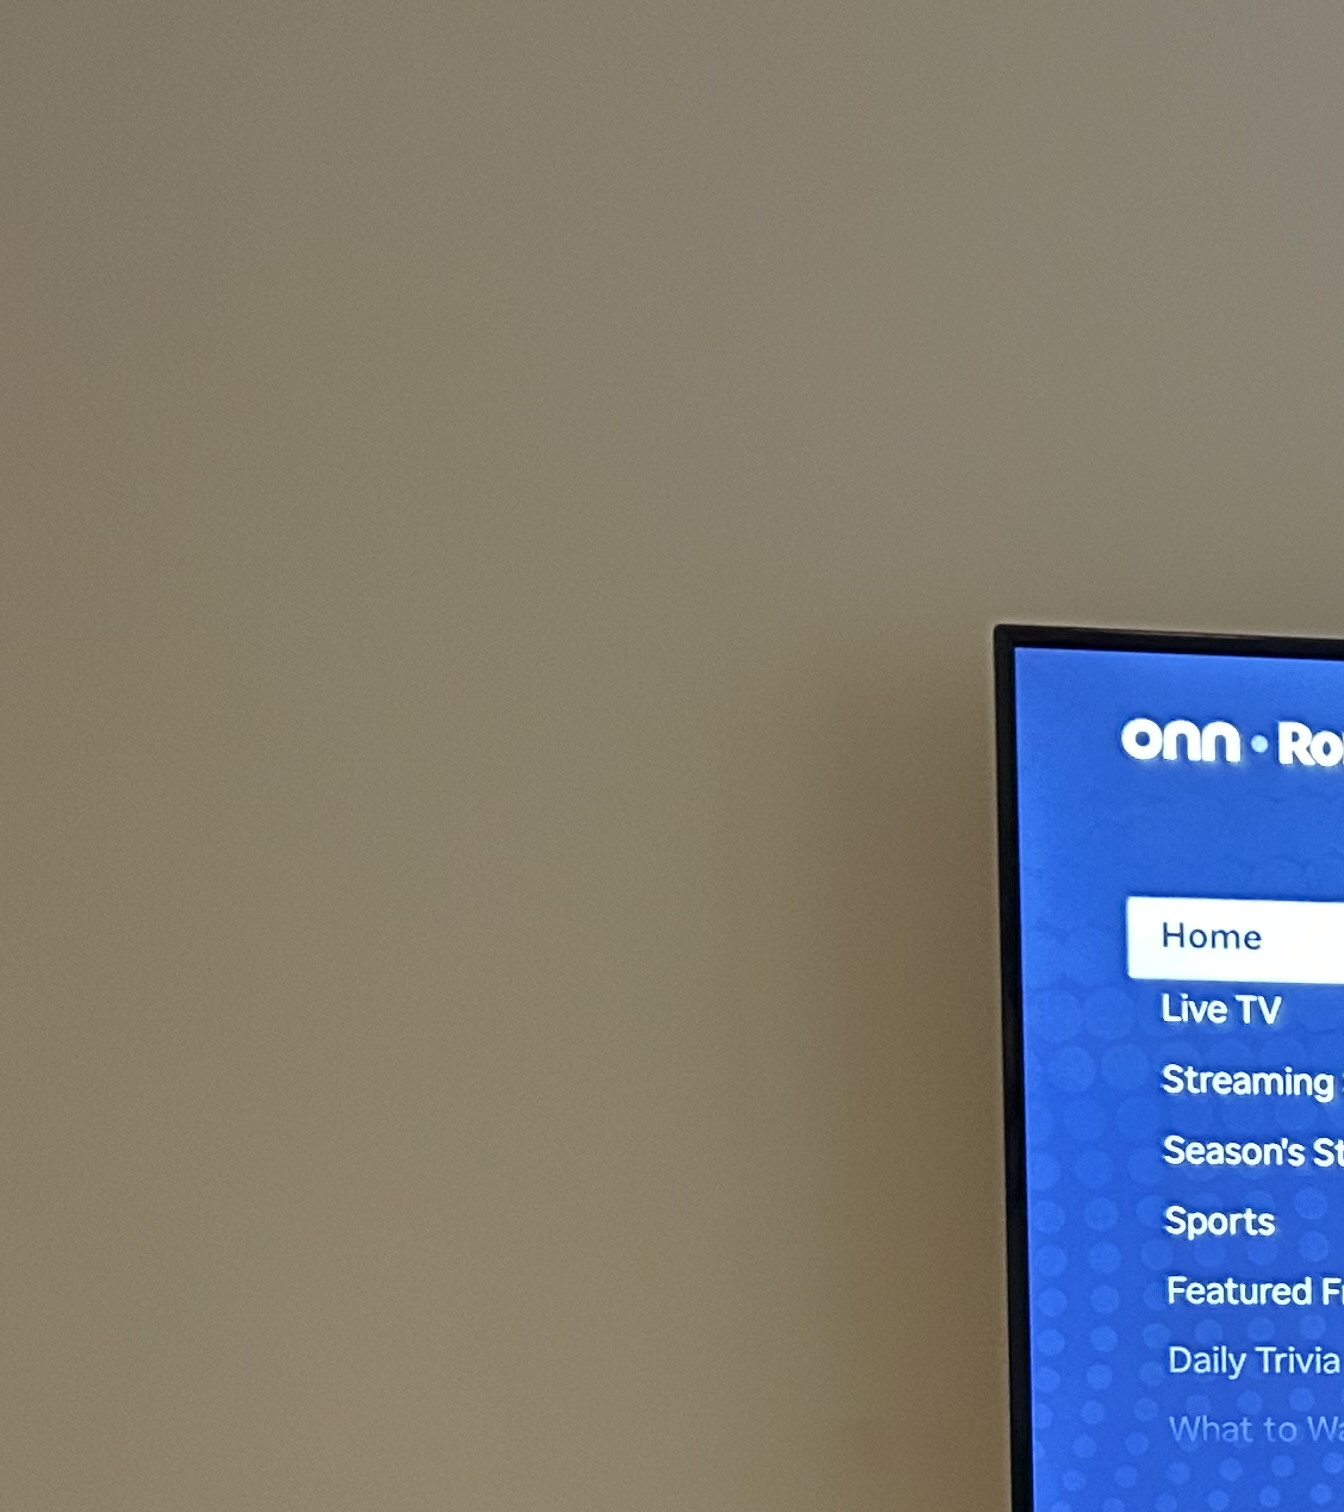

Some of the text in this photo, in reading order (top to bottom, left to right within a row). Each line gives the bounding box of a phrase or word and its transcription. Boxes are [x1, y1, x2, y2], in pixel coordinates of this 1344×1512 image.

[1121, 718, 1241, 763] onn
[1162, 921, 1262, 951] Home
[1162, 993, 1282, 1025] Live TV
[1162, 1063, 1335, 1104] Streaming
[1163, 1134, 1306, 1167] Season's
[1164, 1205, 1276, 1241] Sports
[1168, 1275, 1313, 1306] Featured
[1169, 1345, 1340, 1380] Daily Trivia
[1168, 1415, 1253, 1442] What
[1263, 1416, 1297, 1442] to
